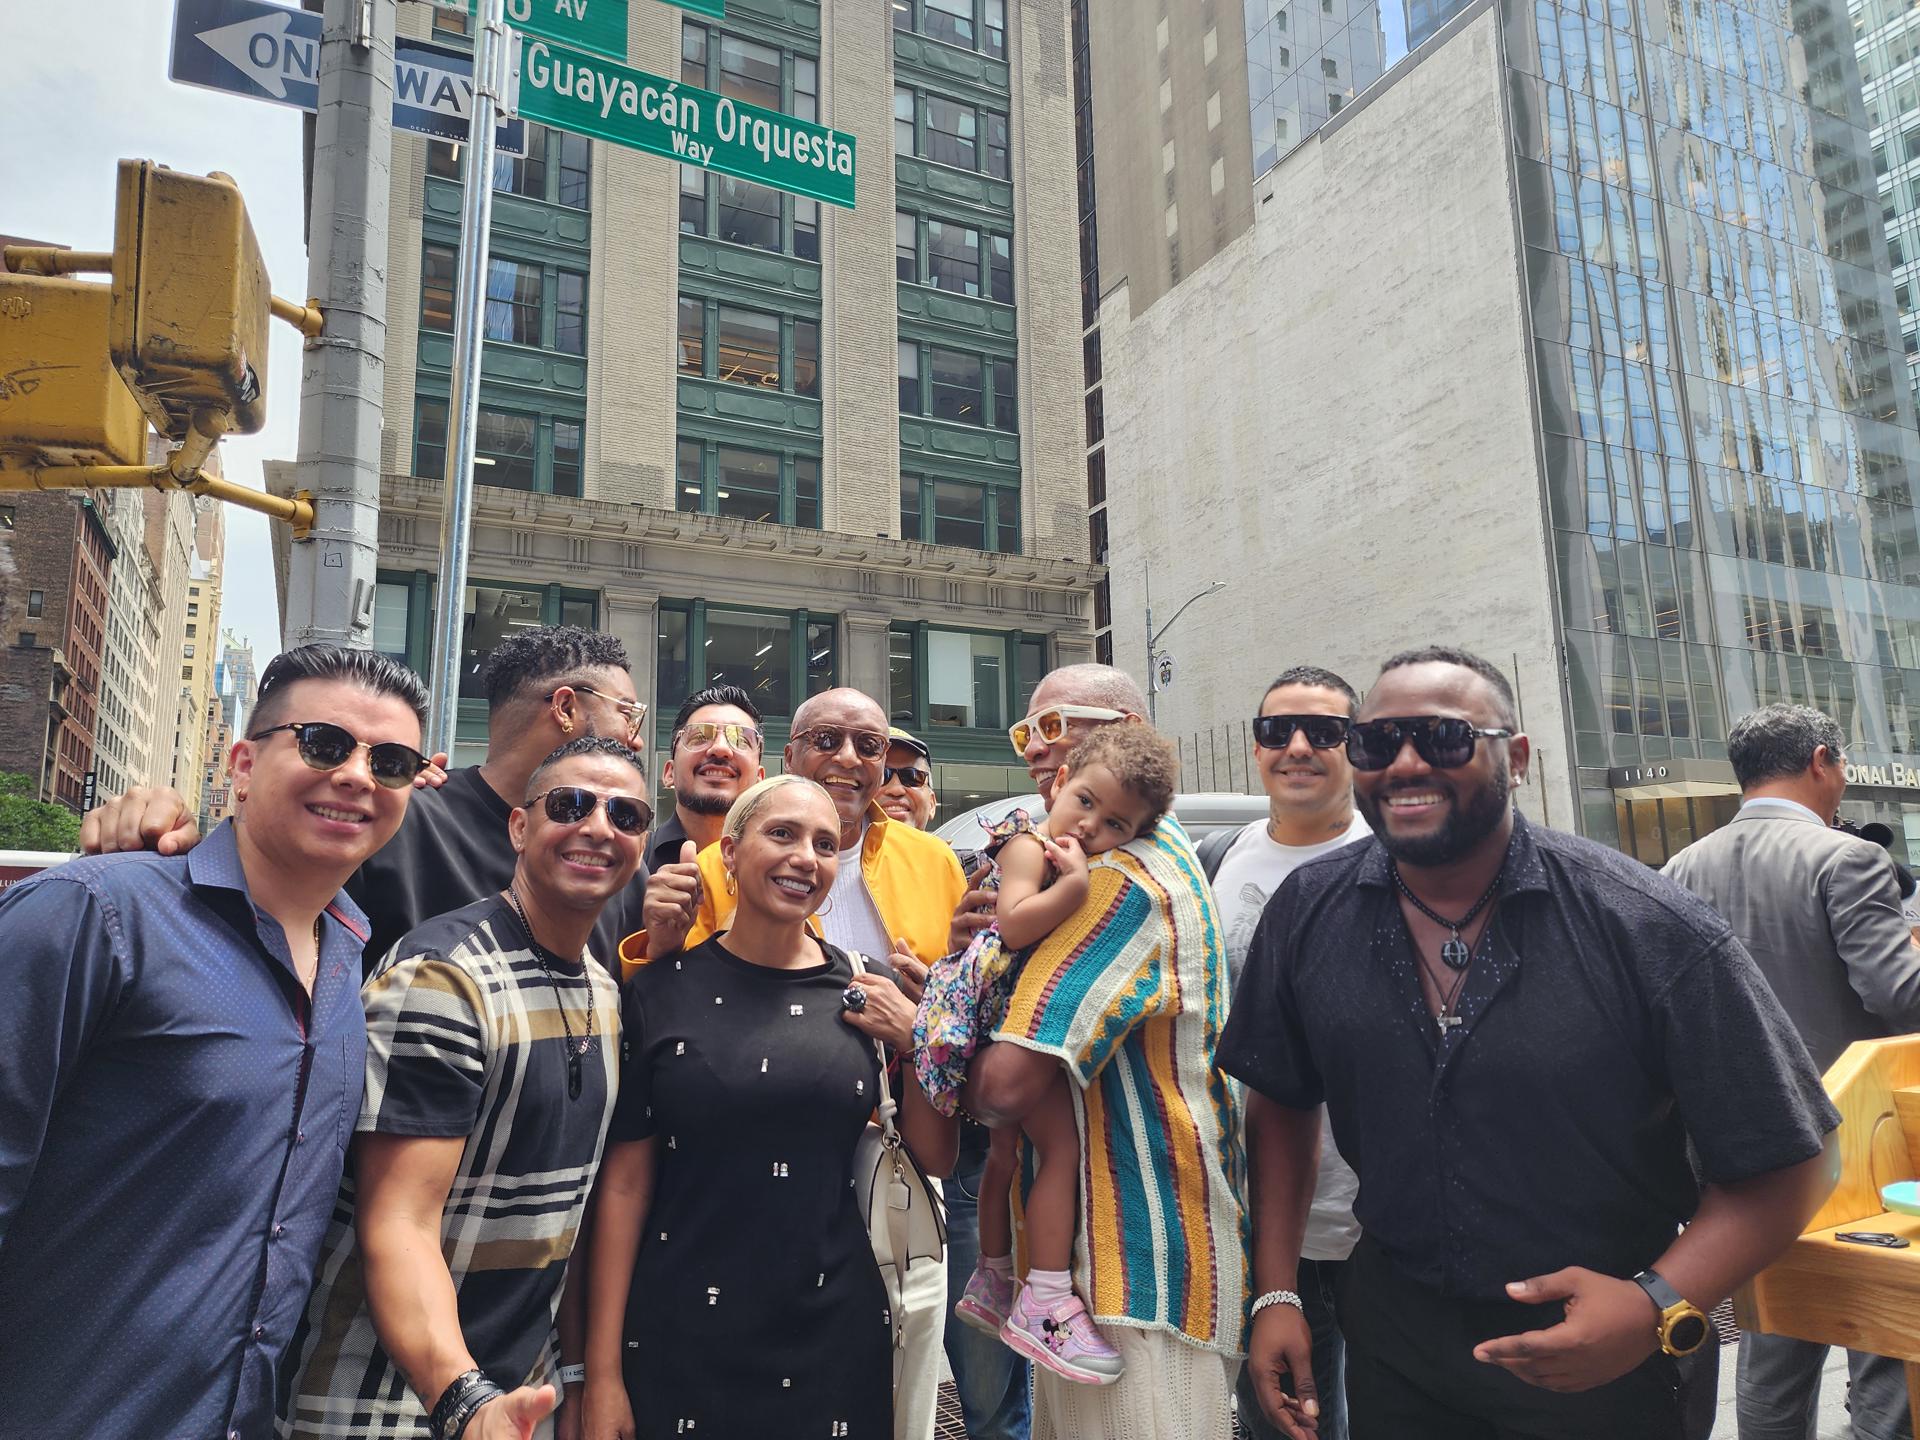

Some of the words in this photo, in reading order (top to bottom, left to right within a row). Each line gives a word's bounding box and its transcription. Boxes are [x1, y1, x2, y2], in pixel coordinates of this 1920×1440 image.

[249, 32, 313, 78] ON
[527, 42, 700, 133] Guayacán
[715, 98, 852, 176] Orquesta
[410, 125, 431, 133] DEPT
[671, 130, 714, 166] Way
[1625, 766, 1667, 781] 1140
[1845, 763, 1893, 785] ONAL
[1891, 762, 1920, 787] BA
